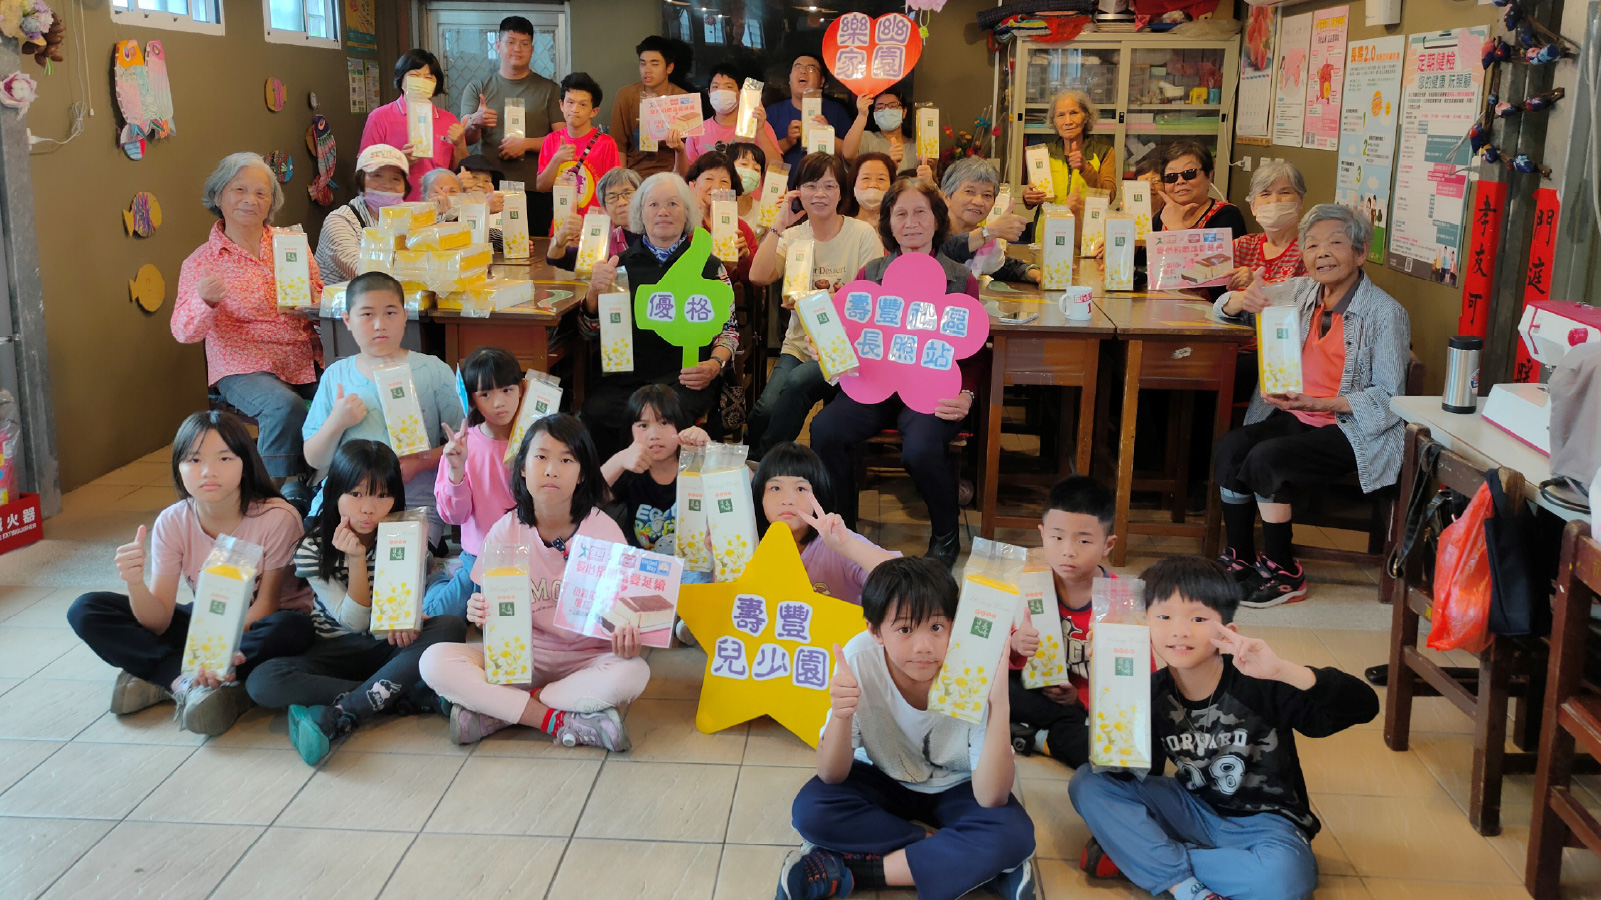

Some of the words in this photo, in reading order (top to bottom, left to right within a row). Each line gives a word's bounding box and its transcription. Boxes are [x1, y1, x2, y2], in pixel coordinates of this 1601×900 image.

[836, 47, 902, 78] 家園
[1417, 51, 1456, 72] 定期健檢
[1362, 139, 1368, 156] 2
[1356, 165, 1362, 183] 3
[819, 266, 846, 275] Dessert
[650, 294, 712, 320] 優格
[857, 330, 951, 368] 長照站
[0, 506, 35, 531] 火器
[646, 565, 657, 573] Way
[733, 597, 810, 640] 壽豐
[714, 638, 827, 688] 兒少園
[1161, 730, 1247, 752] ORWARD
